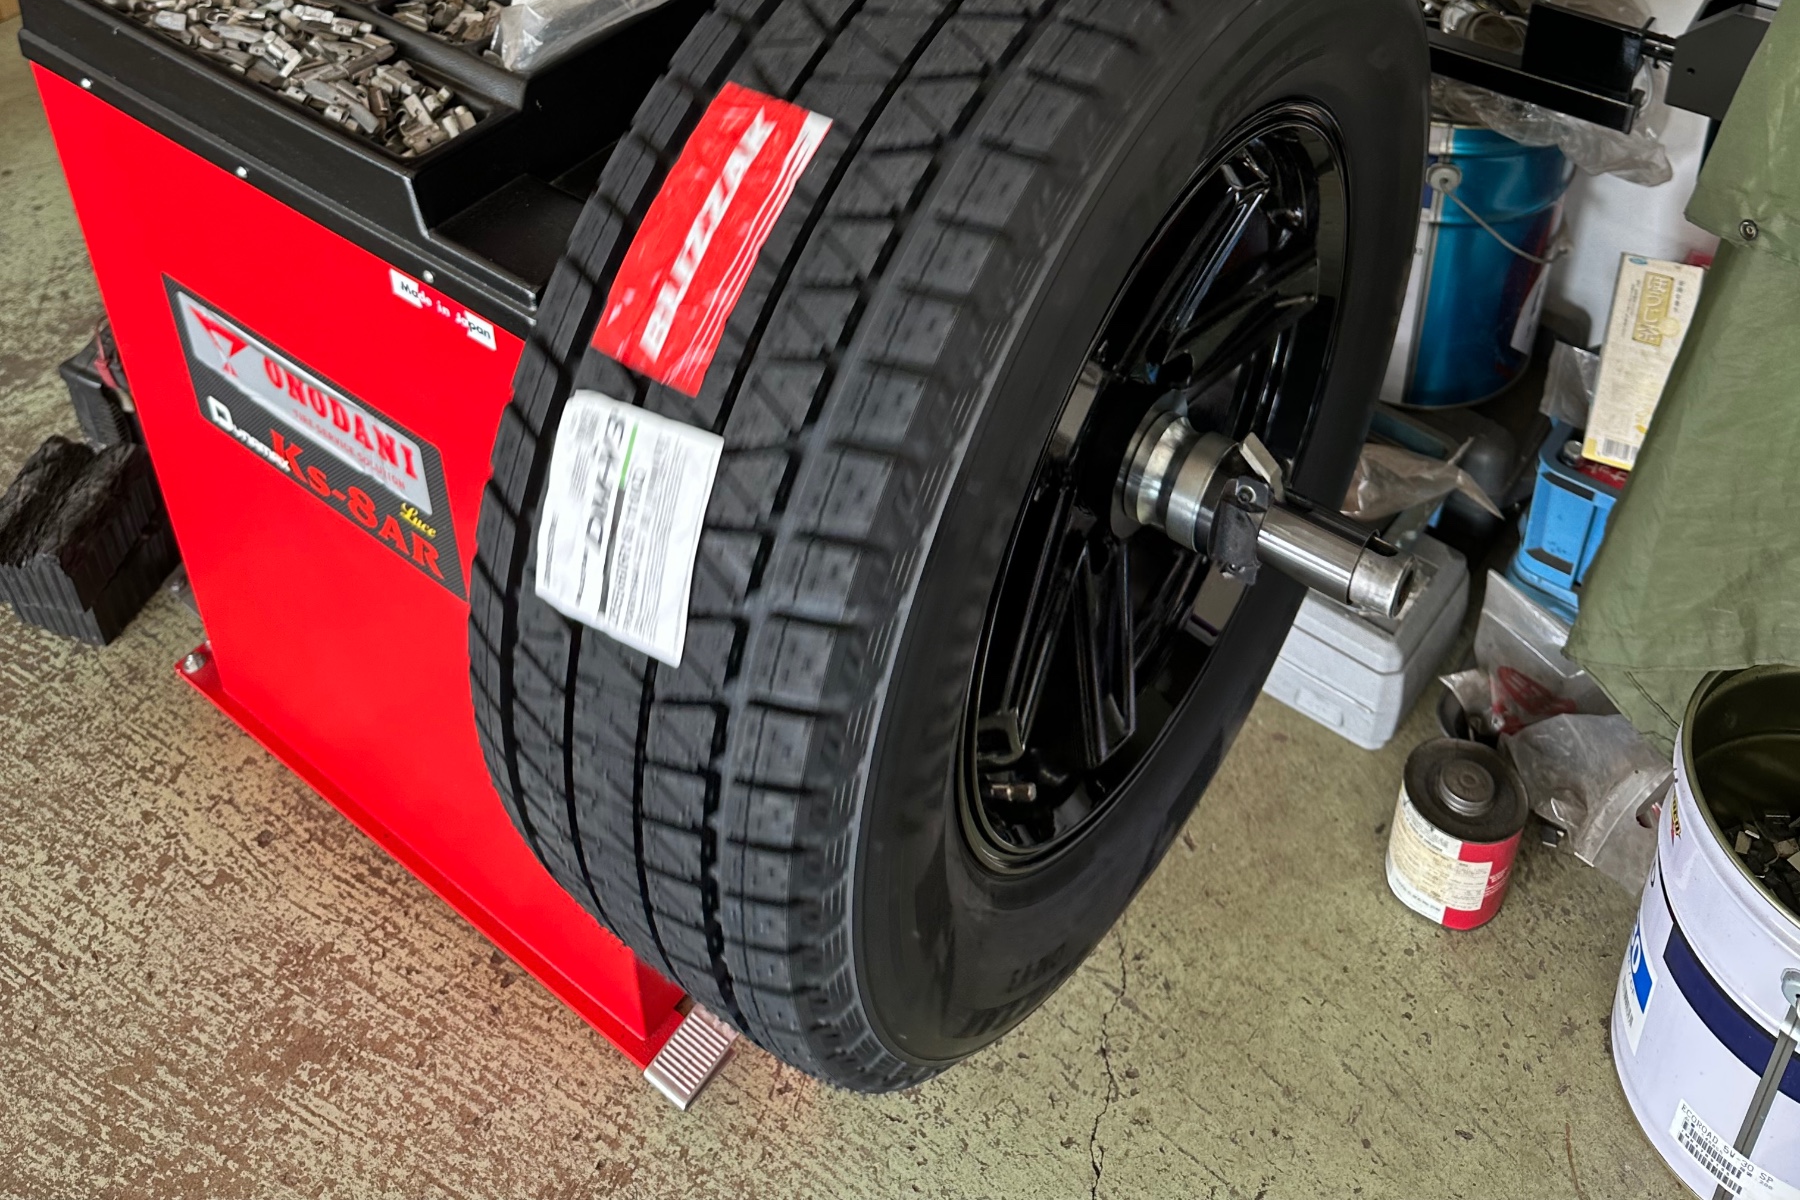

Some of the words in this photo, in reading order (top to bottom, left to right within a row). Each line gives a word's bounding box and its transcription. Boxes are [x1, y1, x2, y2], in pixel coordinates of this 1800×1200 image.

[639, 105, 778, 363] BLIZZAK
[401, 281, 433, 307] Made
[436, 300, 451, 317] in
[455, 312, 491, 340] Japan
[400, 502, 436, 539] Luce
[1681, 1104, 1719, 1145] ECOROAD
[1723, 1144, 1755, 1173] 5W-30
